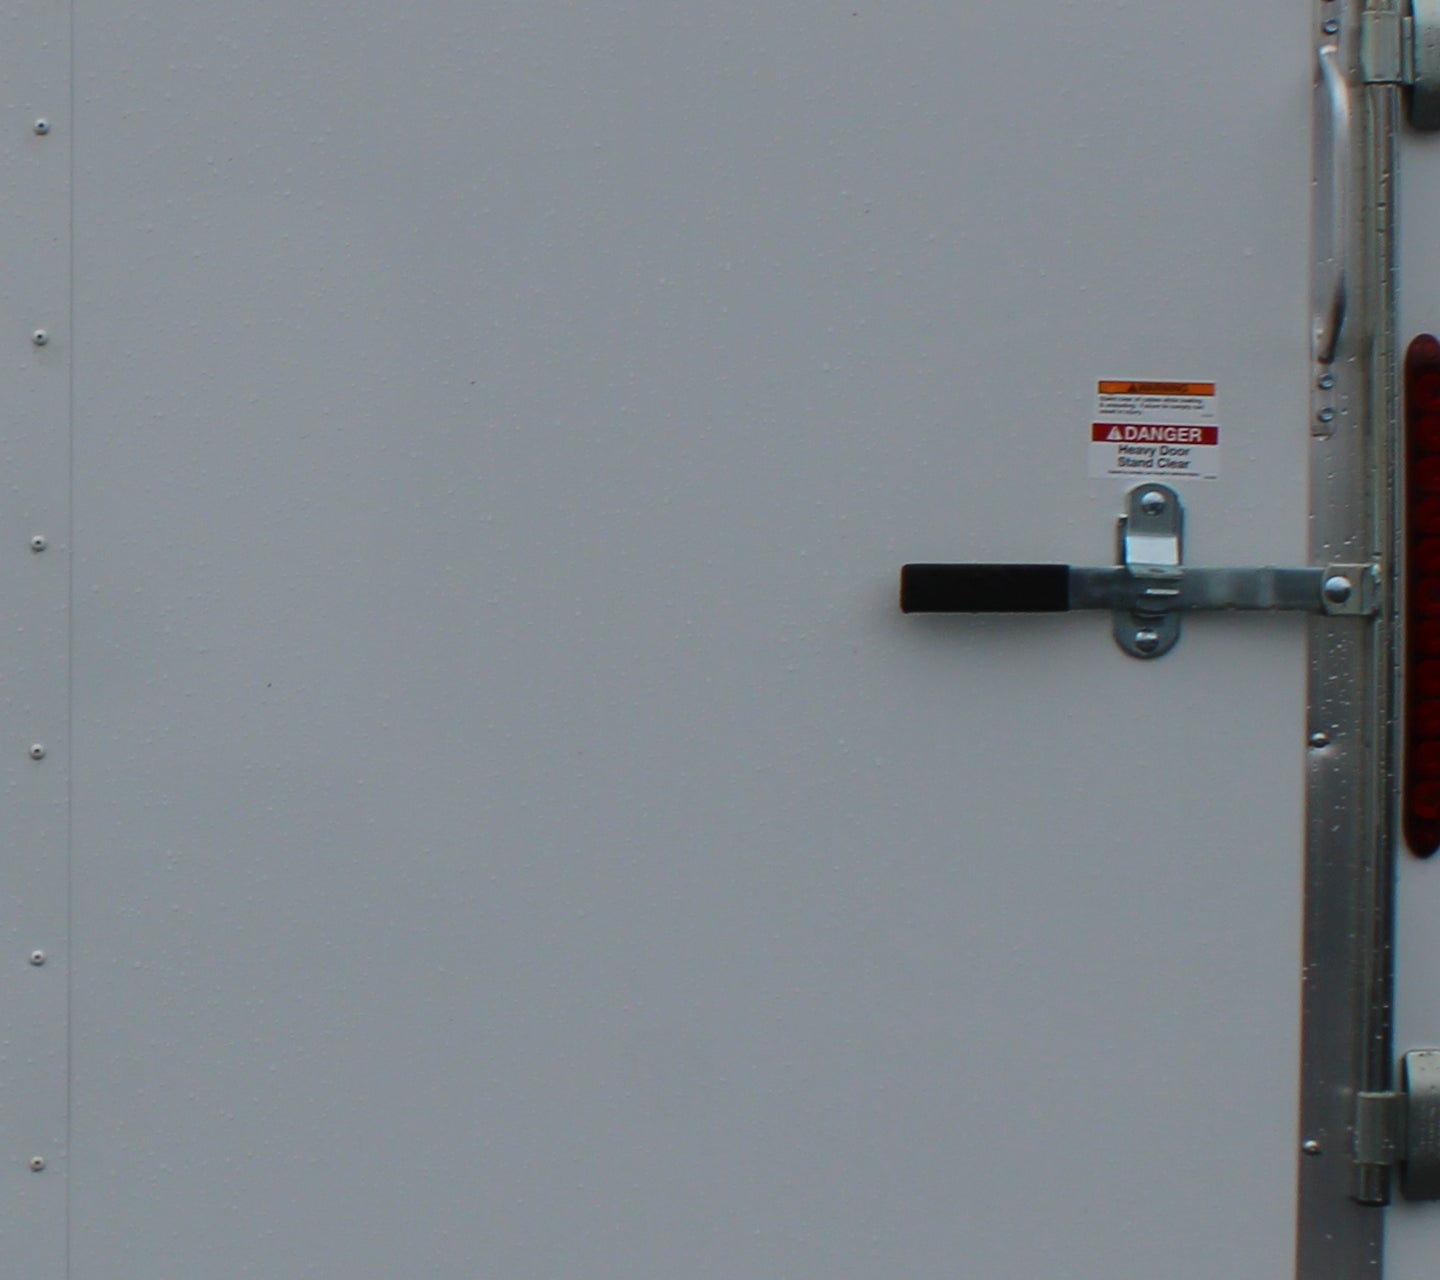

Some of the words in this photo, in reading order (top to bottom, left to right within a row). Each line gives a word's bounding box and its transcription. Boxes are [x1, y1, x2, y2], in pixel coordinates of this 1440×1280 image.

[1124, 426, 1202, 442] DANGER
[1118, 445, 1156, 457] Heavy
[1159, 445, 1191, 456] Door
[1118, 457, 1153, 468] Stand
[1157, 458, 1191, 469] Clear
